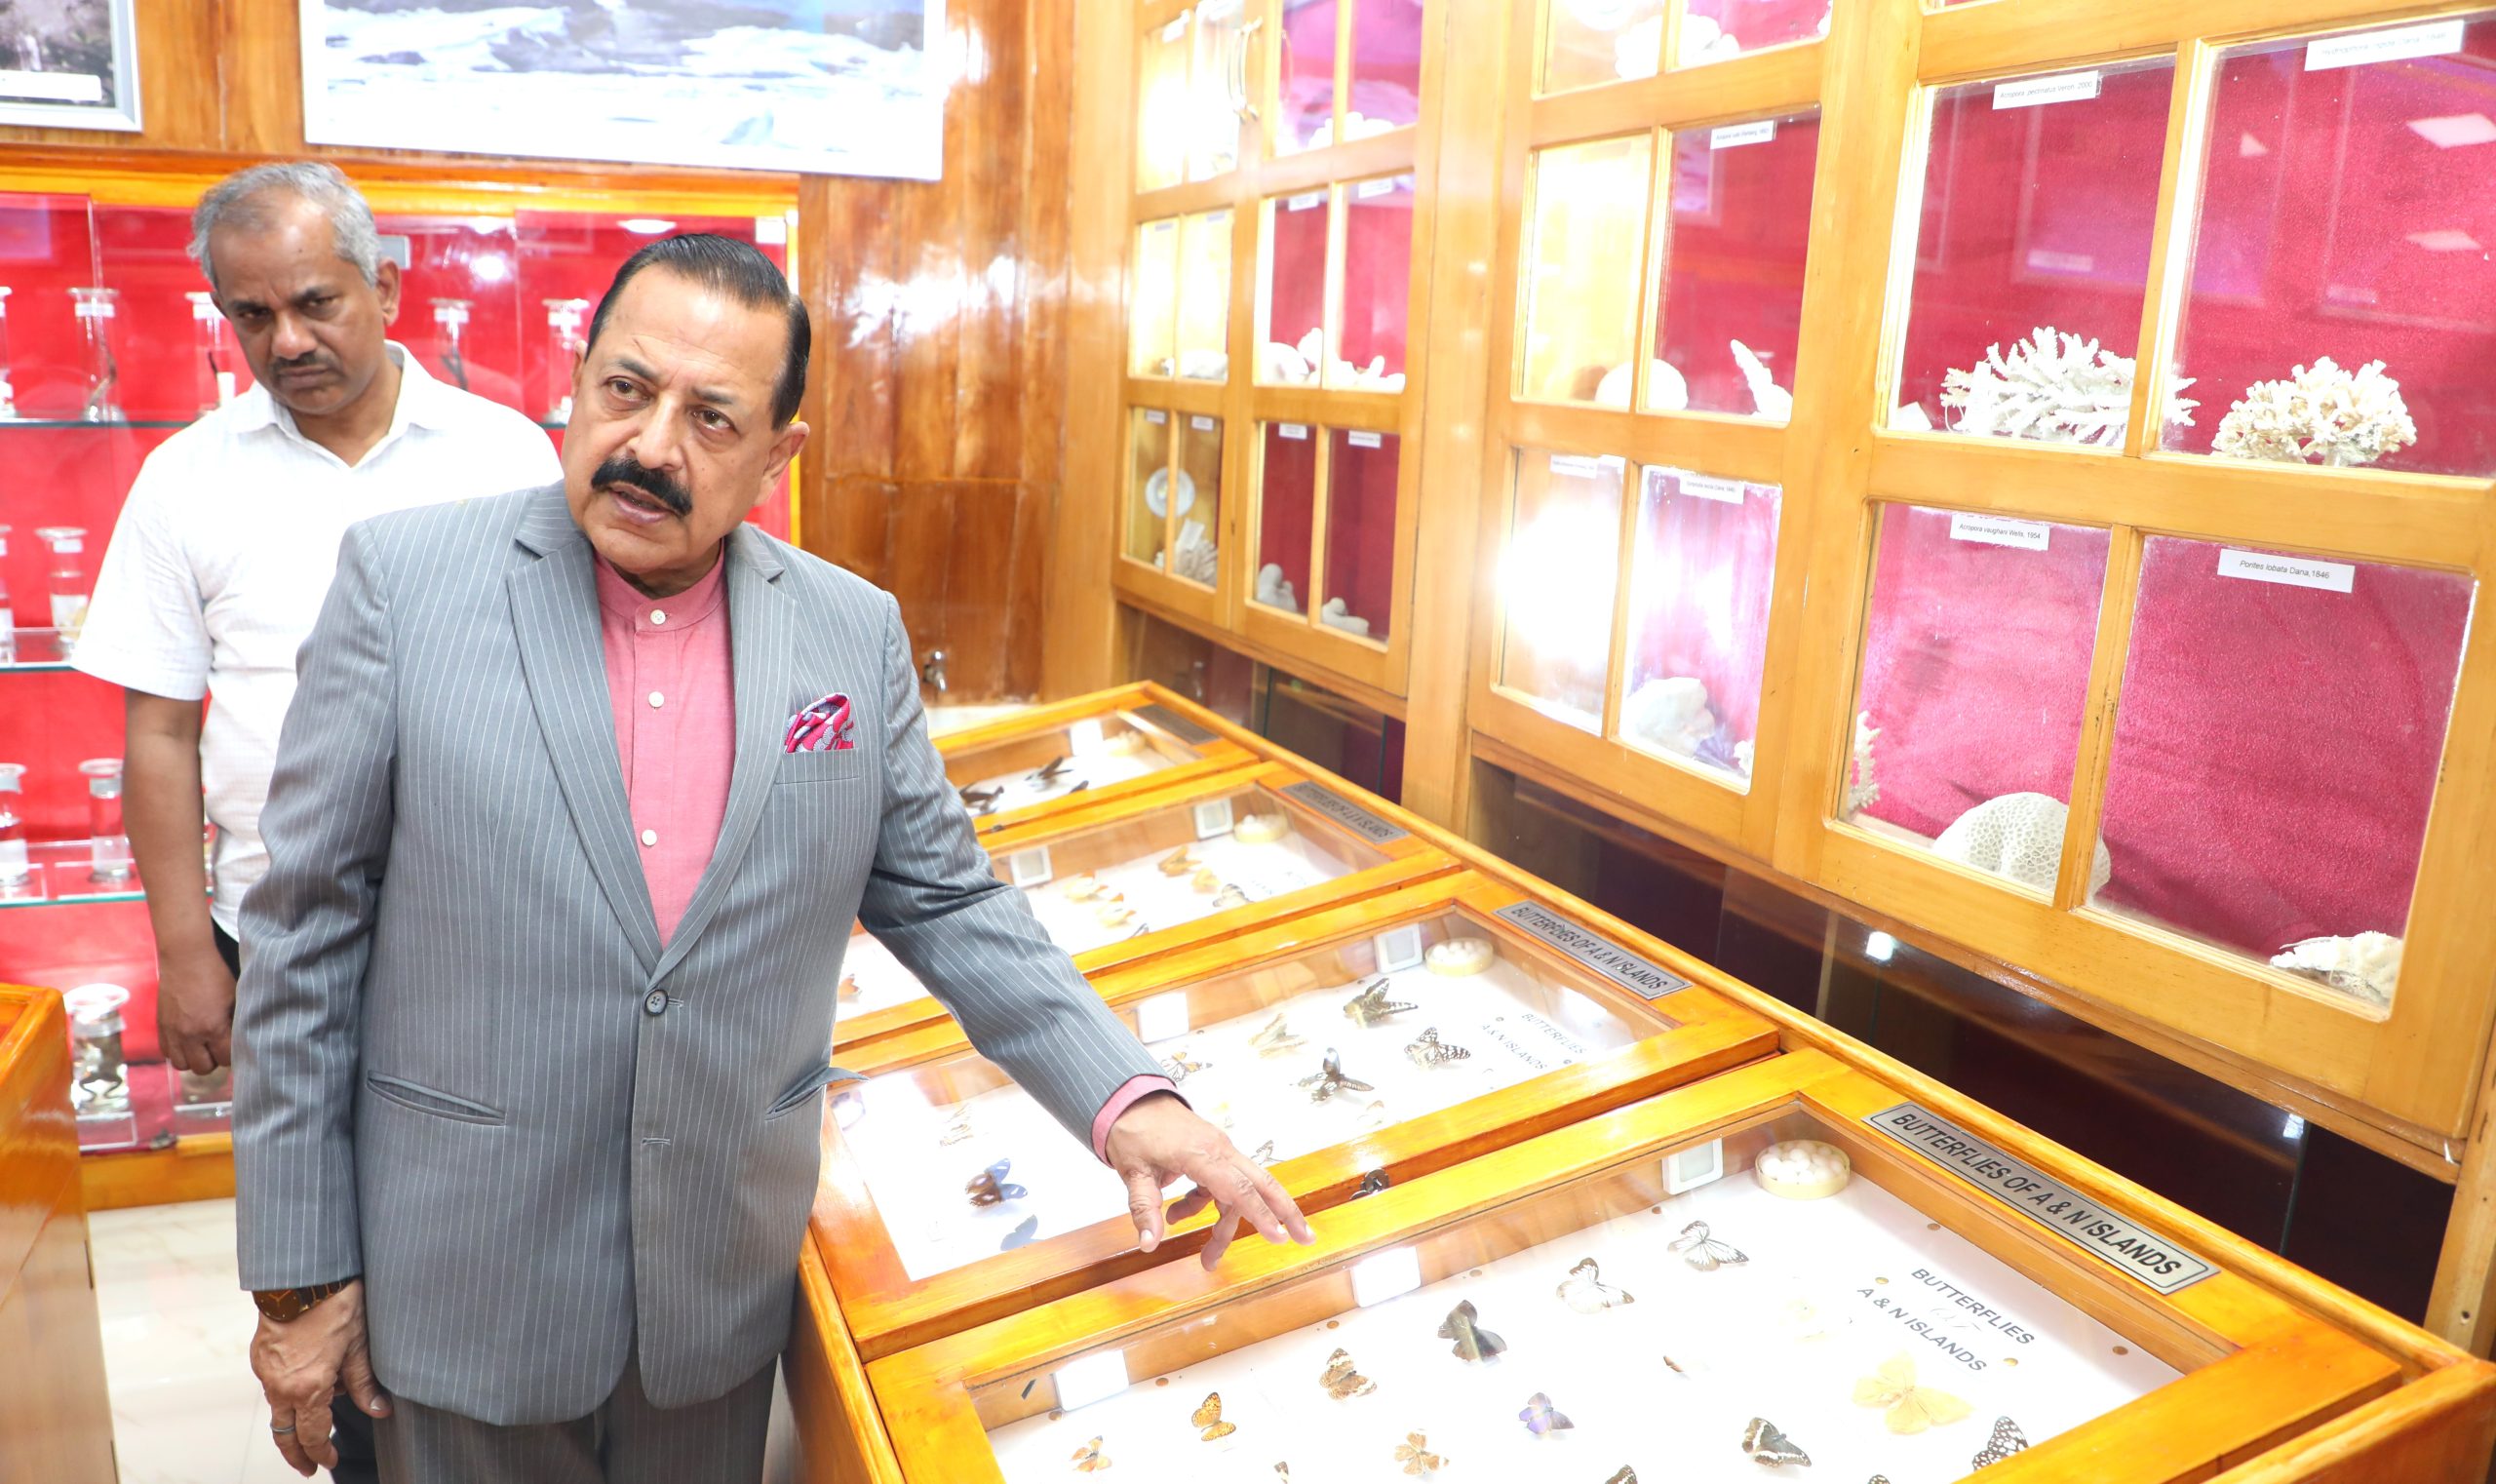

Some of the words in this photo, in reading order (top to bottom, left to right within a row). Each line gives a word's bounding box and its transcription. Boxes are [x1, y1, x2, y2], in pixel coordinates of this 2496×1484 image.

[1959, 524, 1983, 532] Acropora
[2266, 564, 2288, 573] lobata
[1521, 1013, 1587, 1054] BUTTERFLIES
[1891, 1113, 2012, 1180] BUTTERFLIES
[2003, 1176, 2042, 1193] OF
[2028, 1192, 2055, 1206] A
[2047, 1201, 2070, 1215] &
[2062, 1210, 2093, 1225] N
[2079, 1220, 2182, 1276] ISLANDS
[1856, 1288, 1875, 1298] A
[1873, 1298, 1891, 1308] &
[1888, 1308, 1909, 1319] N
[1904, 1317, 1987, 1371] ISLANDS
[1911, 1269, 2035, 1345] BUTTERFLIES
